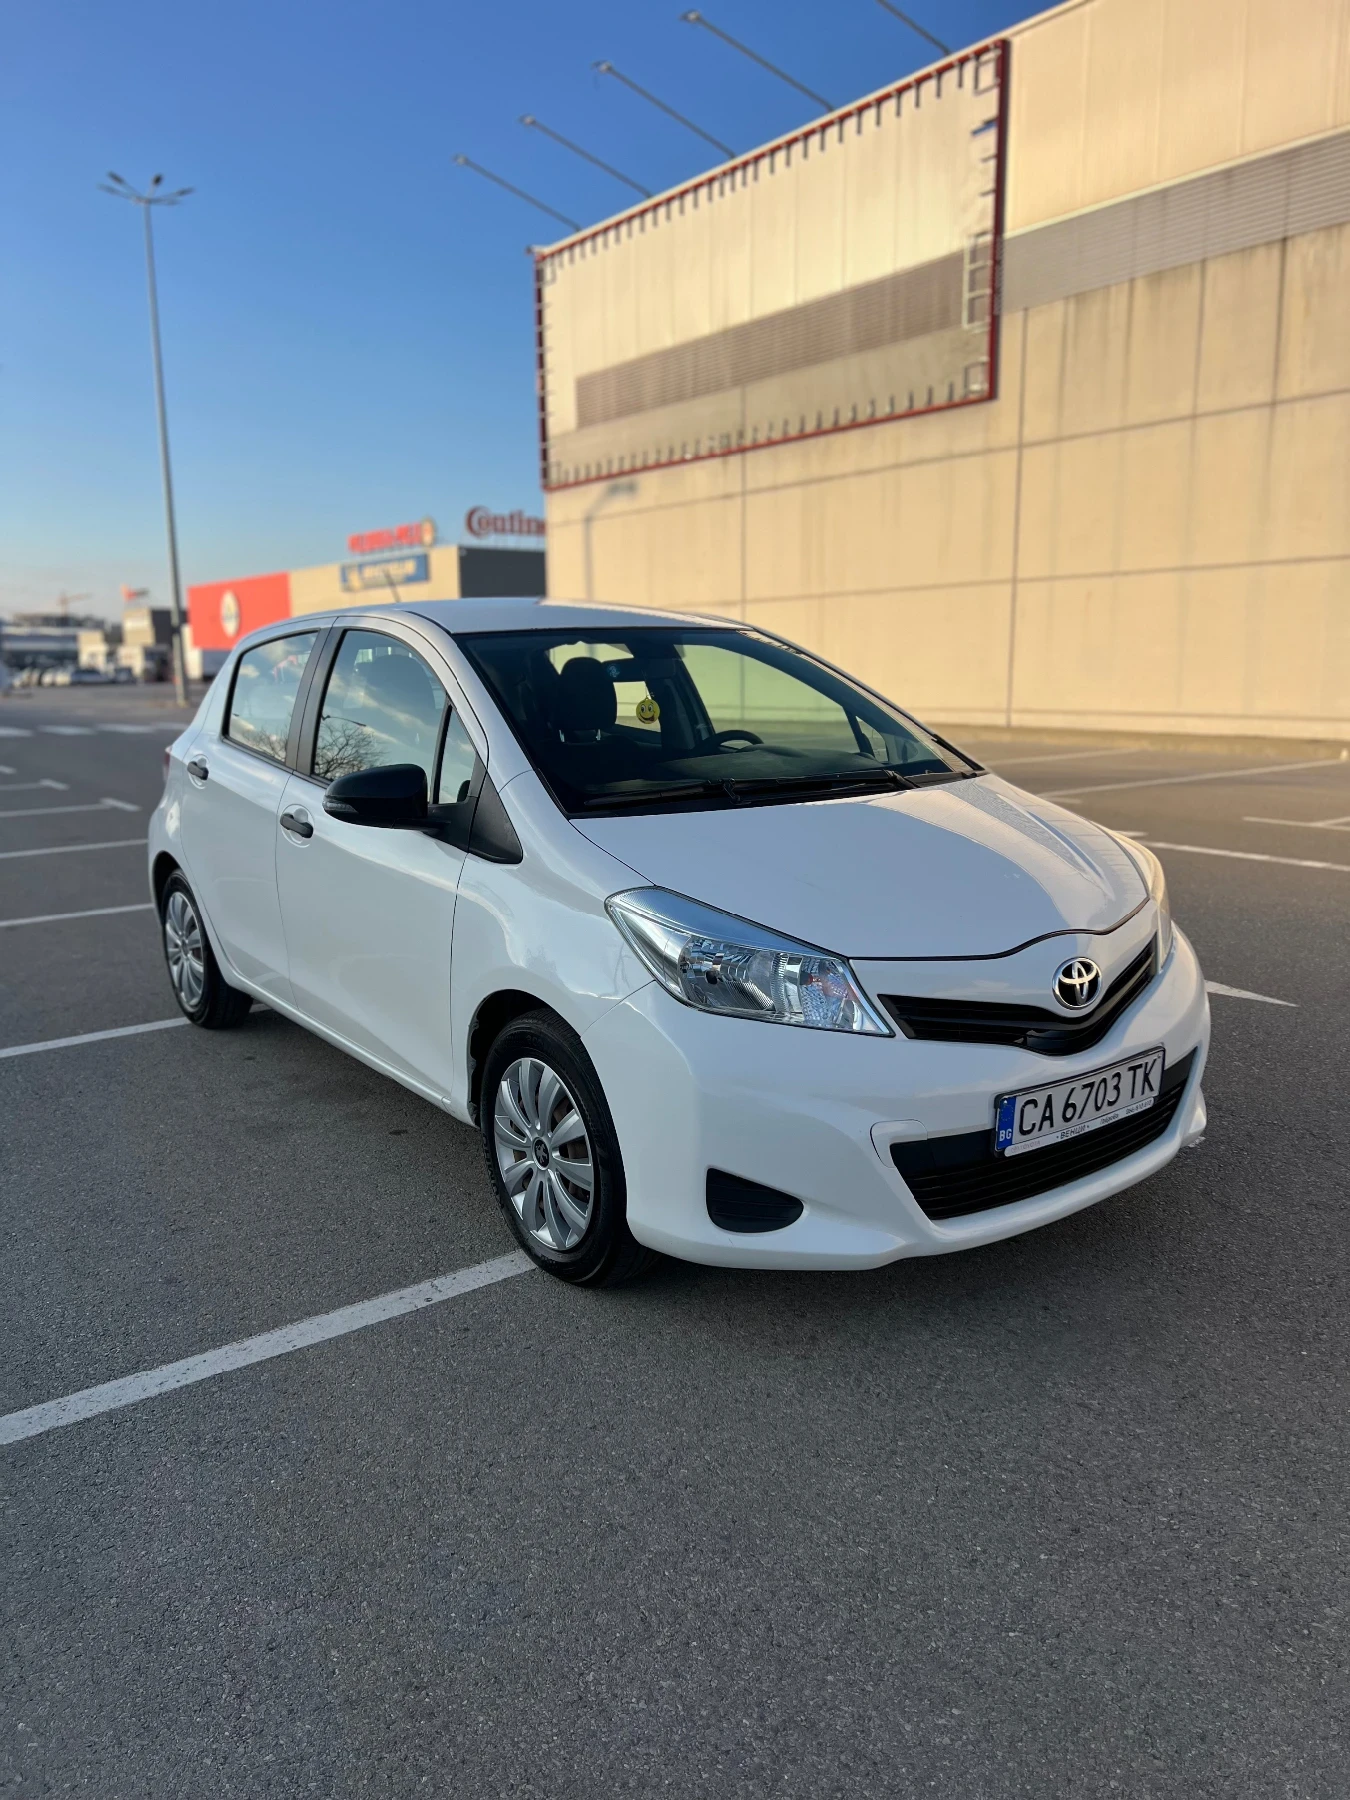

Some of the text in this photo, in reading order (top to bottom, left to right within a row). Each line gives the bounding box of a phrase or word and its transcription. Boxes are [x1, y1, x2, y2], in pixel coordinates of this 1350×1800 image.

[1019, 1058, 1158, 1136] CA 6703 TK
[999, 1128, 1013, 1142] BG
